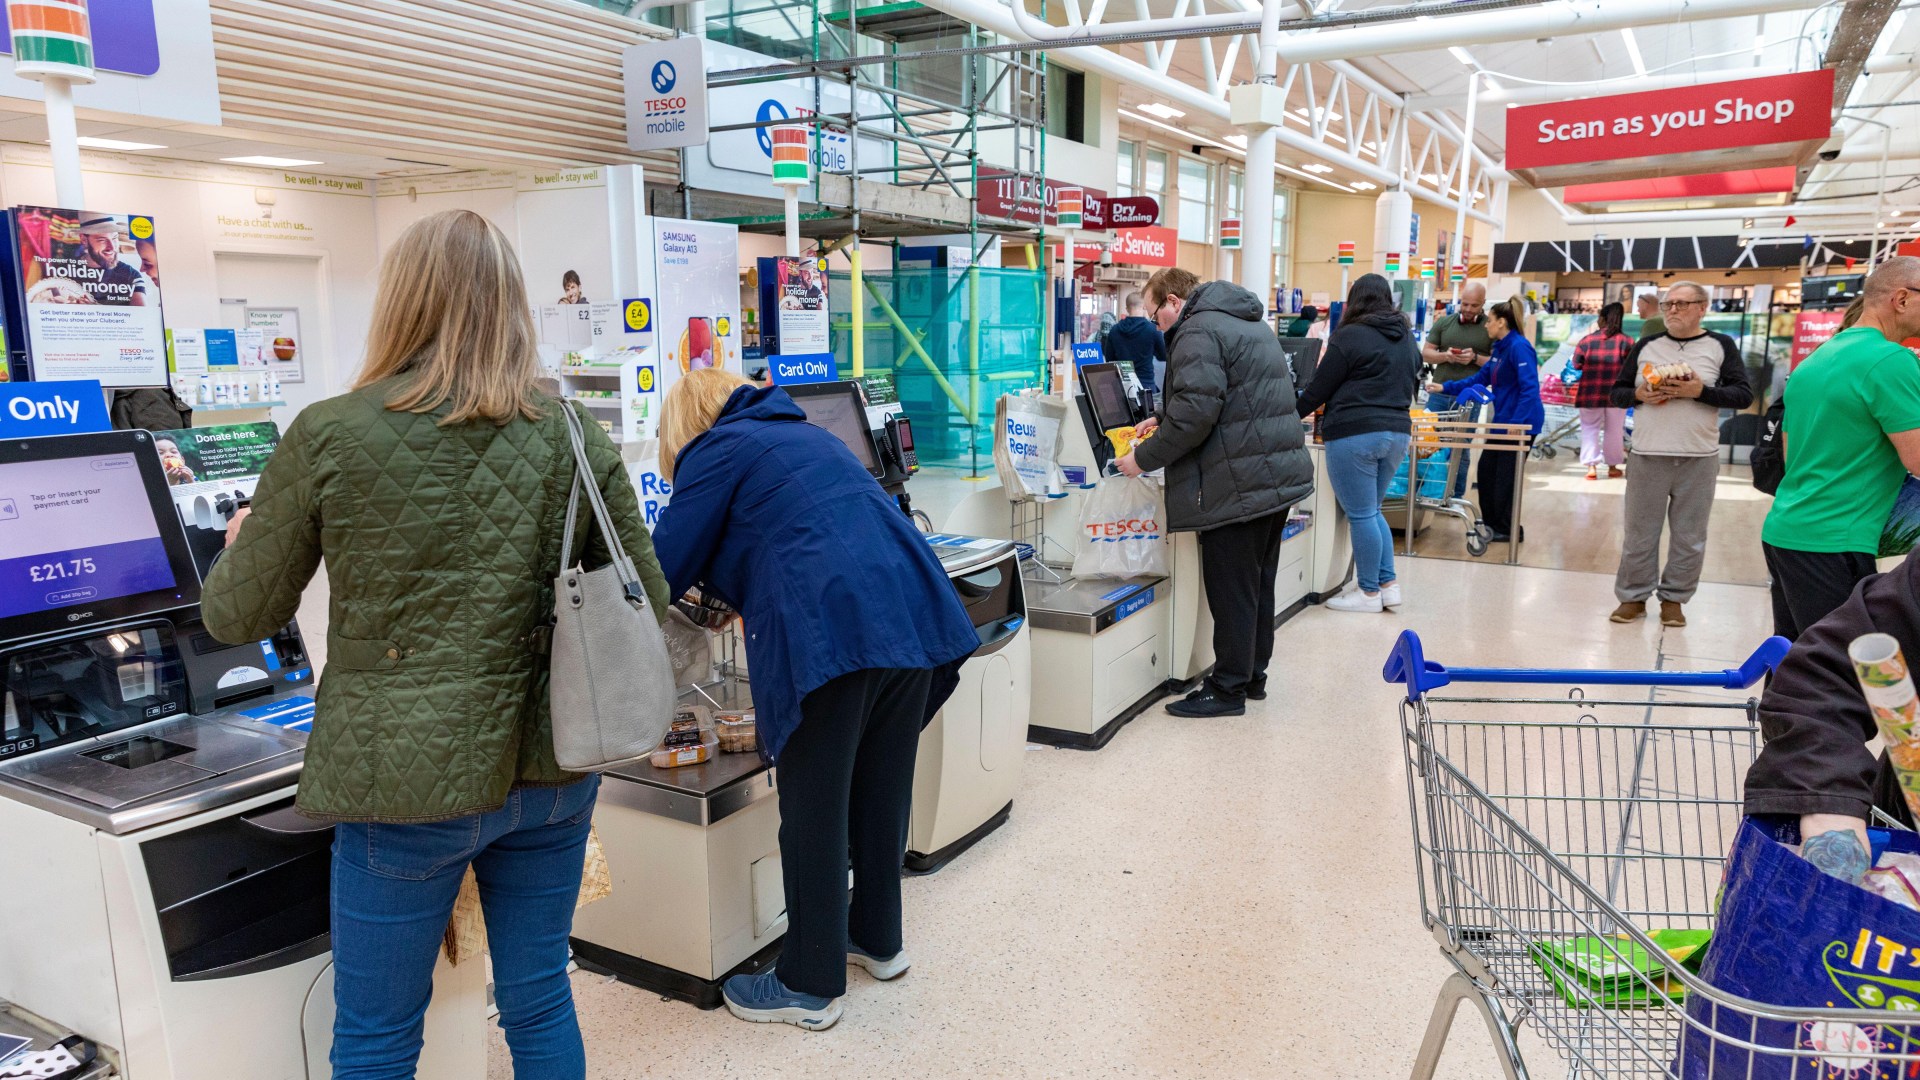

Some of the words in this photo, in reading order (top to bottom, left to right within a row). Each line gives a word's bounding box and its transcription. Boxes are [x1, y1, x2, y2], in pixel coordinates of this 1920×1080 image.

[644, 96, 686, 112] TESCO
[646, 118, 685, 135] mobile
[1537, 118, 1605, 144] Scan
[1612, 115, 1645, 136] as
[1650, 107, 1706, 137] you
[1713, 97, 1795, 125] Shop
[284, 173, 296, 184] be
[299, 175, 317, 186] well
[325, 179, 343, 190] stay
[345, 181, 363, 190] well
[534, 174, 544, 184] be
[545, 172, 560, 183] well
[565, 172, 581, 183] stay
[582, 170, 598, 181] well
[1085, 194, 1101, 214] Dry
[1112, 203, 1136, 218] Dry
[217, 215, 242, 226] Have
[251, 218, 270, 228] chat
[272, 219, 292, 229] with
[1083, 212, 1103, 225] Cleaning
[1112, 213, 1152, 224] Cleaning
[662, 231, 697, 244] SAMSUNG
[1125, 231, 1165, 257] Services
[663, 243, 686, 255] Galaxy
[686, 244, 698, 254] A13
[33, 255, 47, 263] The
[47, 257, 68, 265] power
[77, 258, 88, 266] get
[663, 256, 676, 265] Save
[46, 263, 105, 282] holiday
[82, 281, 136, 297] money
[785, 287, 808, 297] holiday
[798, 297, 820, 305] money
[631, 308, 643, 319] £4
[593, 327, 603, 336] £5
[1076, 349, 1087, 359] Card
[1087, 348, 1099, 359] Only
[778, 362, 803, 378] Card
[804, 361, 828, 378] Only
[8, 395, 80, 424] Only
[1007, 418, 1037, 438] Reuse
[195, 432, 232, 444] Donate
[232, 430, 259, 440] here.
[31, 494, 46, 502] Tap
[58, 489, 83, 499] insert
[83, 488, 101, 497] your
[33, 500, 70, 511] payment
[71, 497, 89, 505] card
[1086, 518, 1159, 537] TESCO
[29, 557, 97, 583] £21.75
